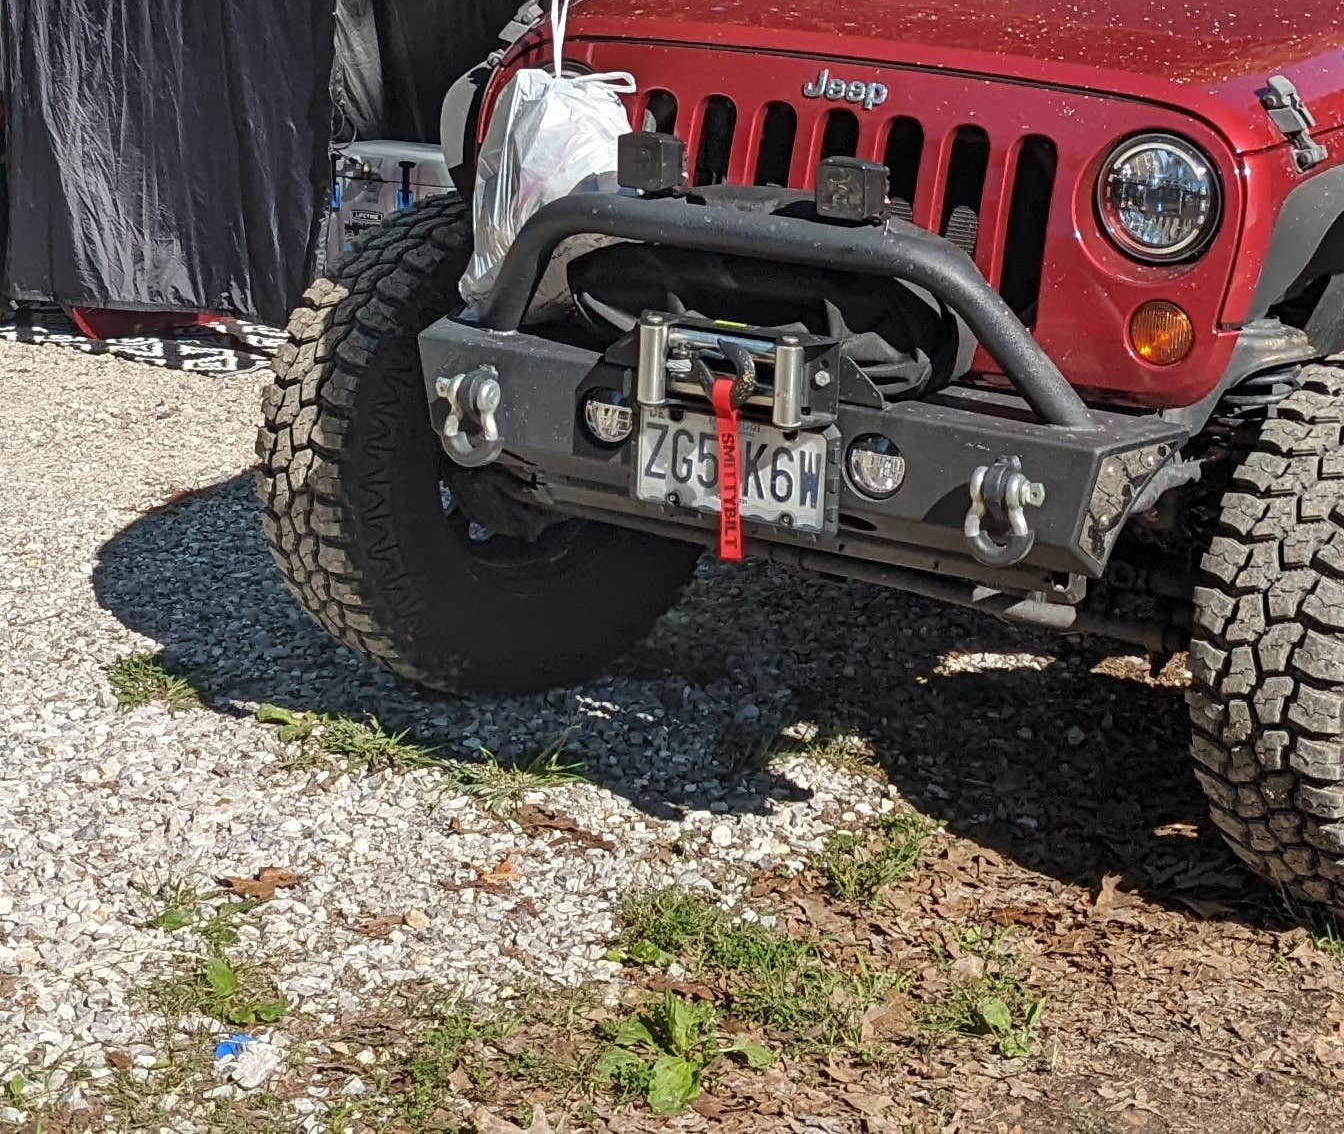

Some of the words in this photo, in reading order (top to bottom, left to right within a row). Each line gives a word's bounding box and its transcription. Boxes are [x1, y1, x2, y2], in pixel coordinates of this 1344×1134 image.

[803, 68, 889, 111] Jeep
[720, 433, 738, 550] SMITTYBILT
[742, 441, 822, 509] K6W
